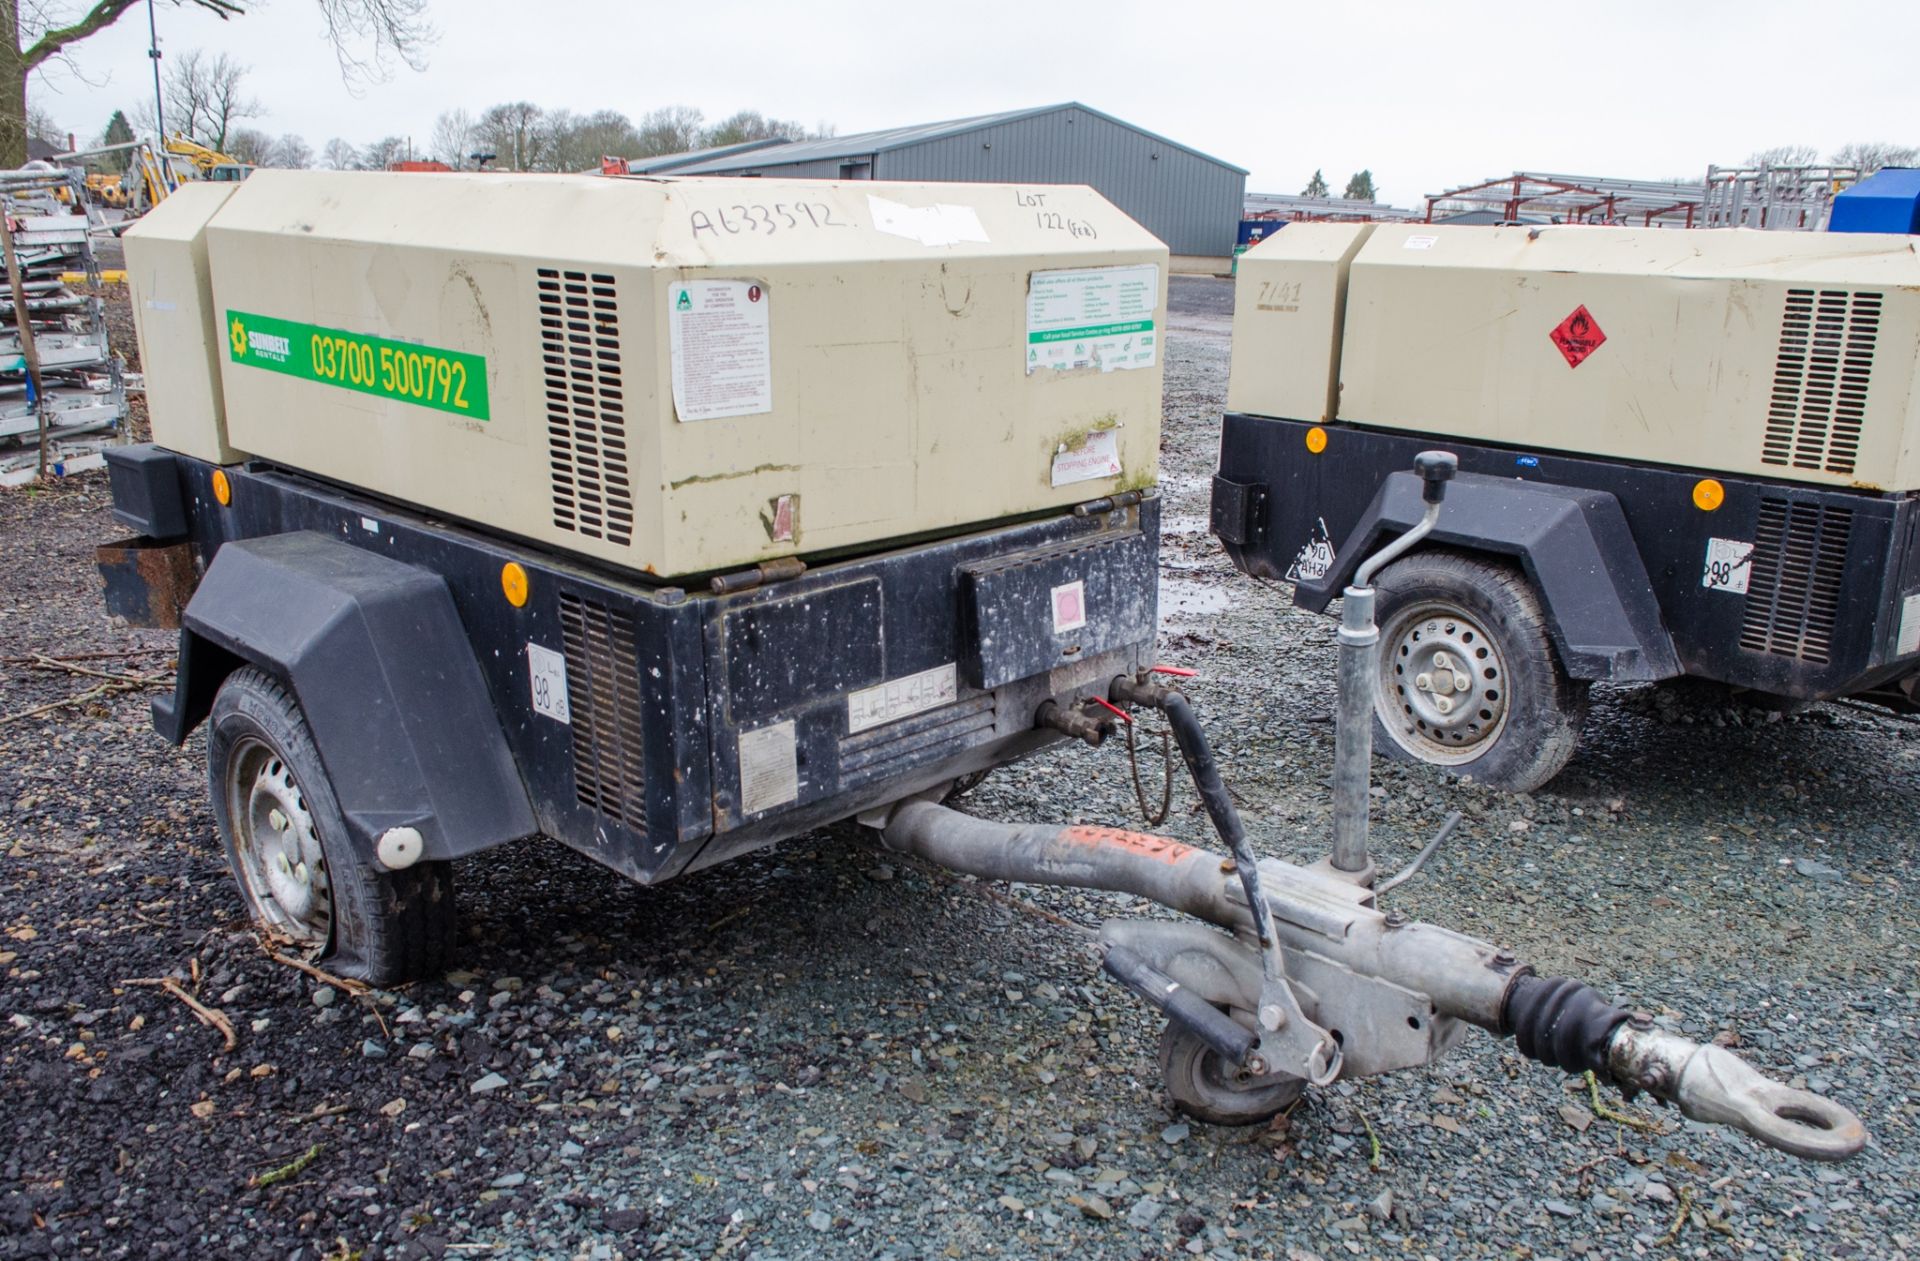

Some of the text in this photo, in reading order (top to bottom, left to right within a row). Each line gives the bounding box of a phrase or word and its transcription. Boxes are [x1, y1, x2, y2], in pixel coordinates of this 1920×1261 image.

[1016, 190, 1046, 207] LOT
[1037, 212, 1064, 229] 122
[248, 331, 291, 355] SUNBELT
[255, 350, 286, 362] RENTALS
[311, 334, 469, 408] 03700 500792
[1056, 459, 1087, 473] STOPPING
[535, 674, 550, 709] 98
